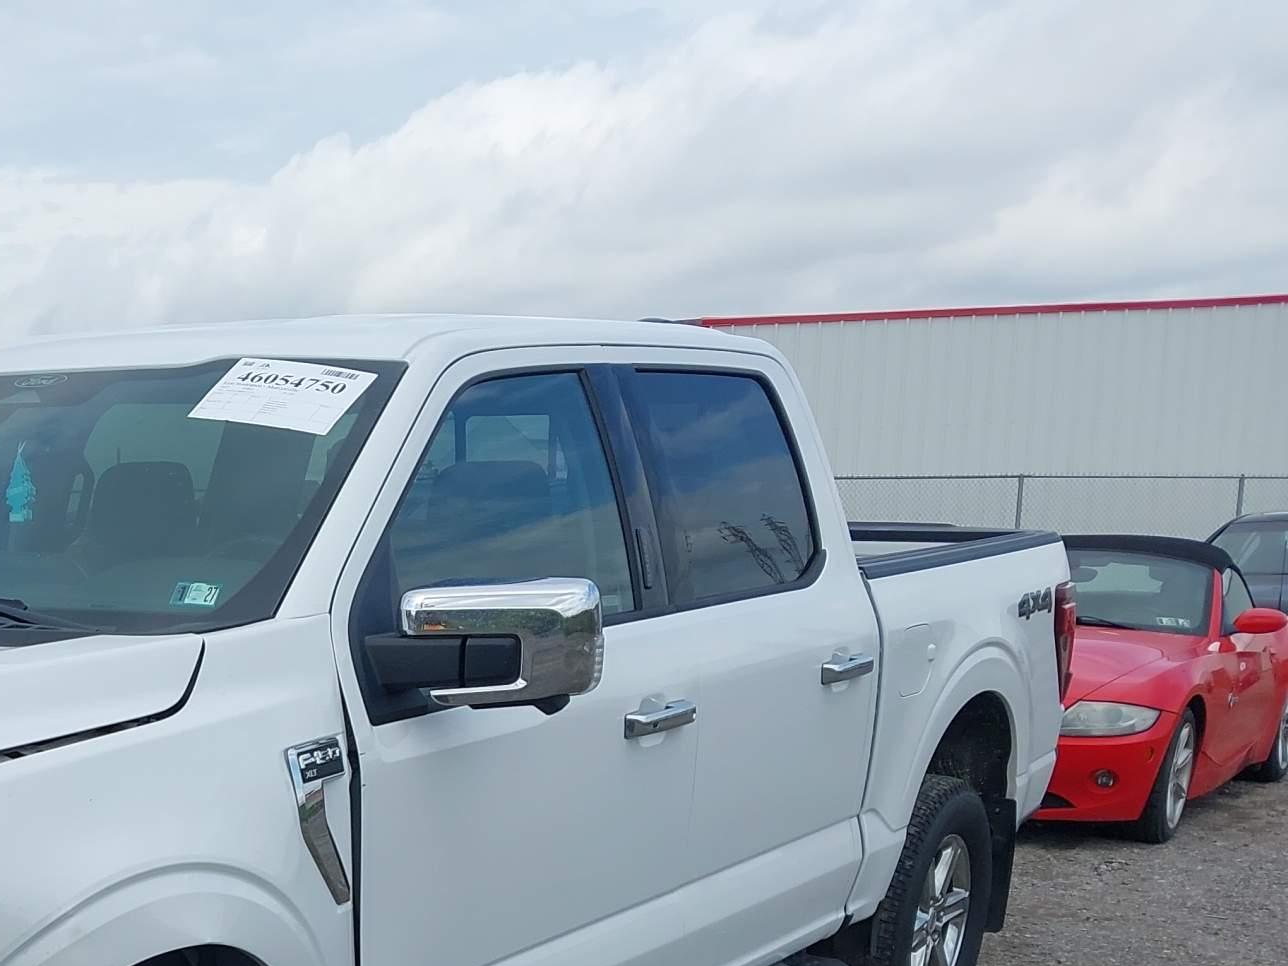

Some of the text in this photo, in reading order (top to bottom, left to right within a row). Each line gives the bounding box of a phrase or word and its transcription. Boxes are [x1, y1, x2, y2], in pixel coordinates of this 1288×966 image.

[237, 371, 347, 394] 46054750
[203, 586, 218, 602] 27
[306, 768, 318, 779] XLT
